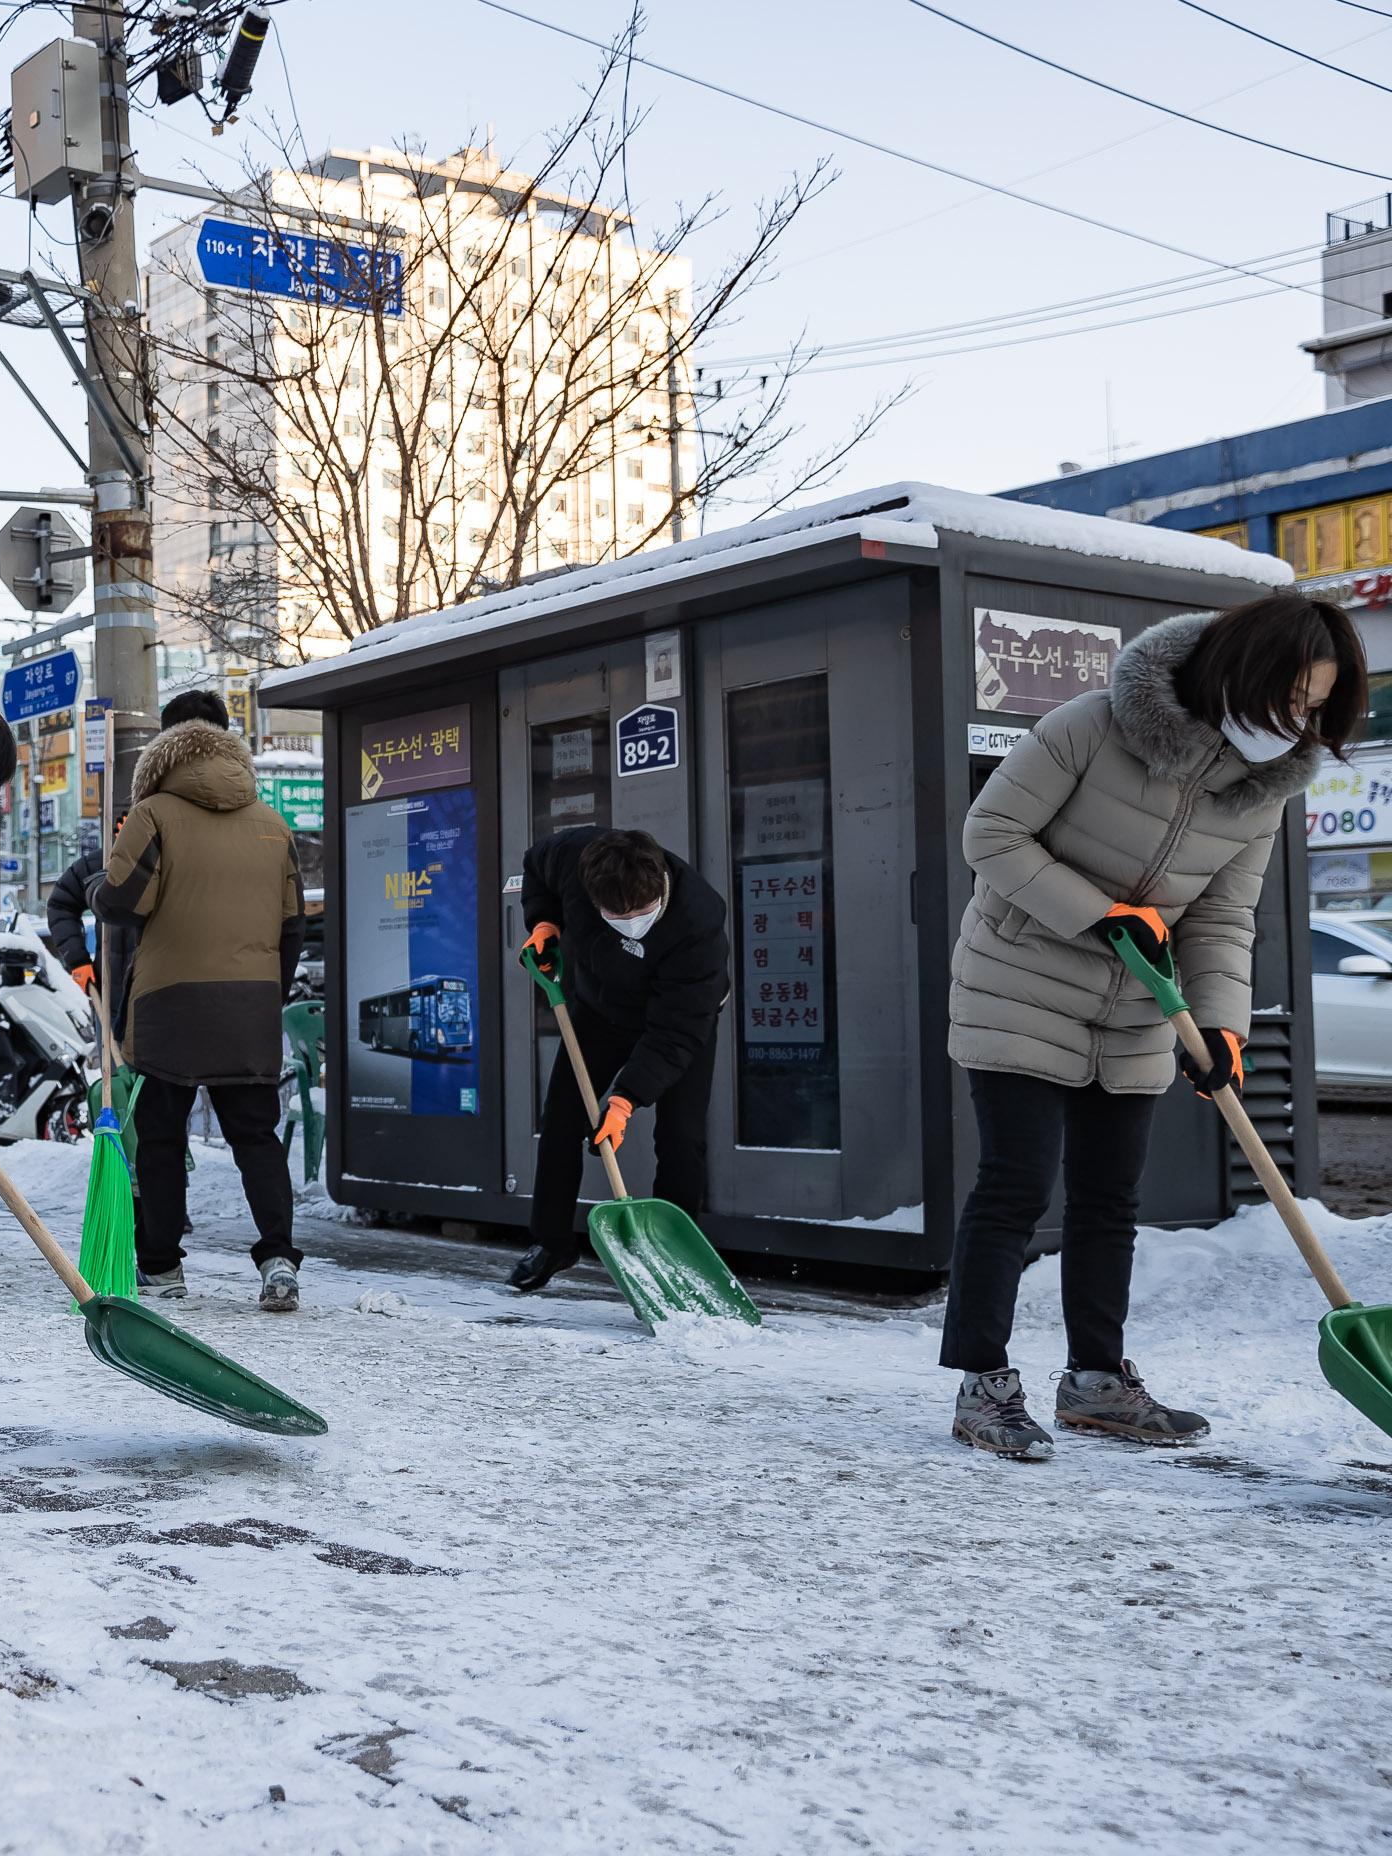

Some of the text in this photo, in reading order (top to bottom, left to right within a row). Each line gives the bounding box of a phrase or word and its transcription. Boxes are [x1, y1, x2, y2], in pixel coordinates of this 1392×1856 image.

[252, 234, 335, 276] 자양로
[988, 638, 1109, 685] 구두수선·광택
[25, 663, 54, 685] 자양로
[65, 670, 76, 686] 87
[3, 690, 13, 704] 91
[636, 713, 657, 726] 자양로
[370, 726, 460, 768] 구두수선·광택
[623, 736, 671, 767] 89-2
[1305, 808, 1376, 836] 7080
[750, 875, 817, 899] 구두수선
[752, 911, 813, 934] 광 택
[753, 945, 814, 968] 염 색
[759, 981, 809, 1003] 운동화
[751, 1007, 818, 1028] 뒷굽수선
[747, 1047, 821, 1061] 010-8863-1497
